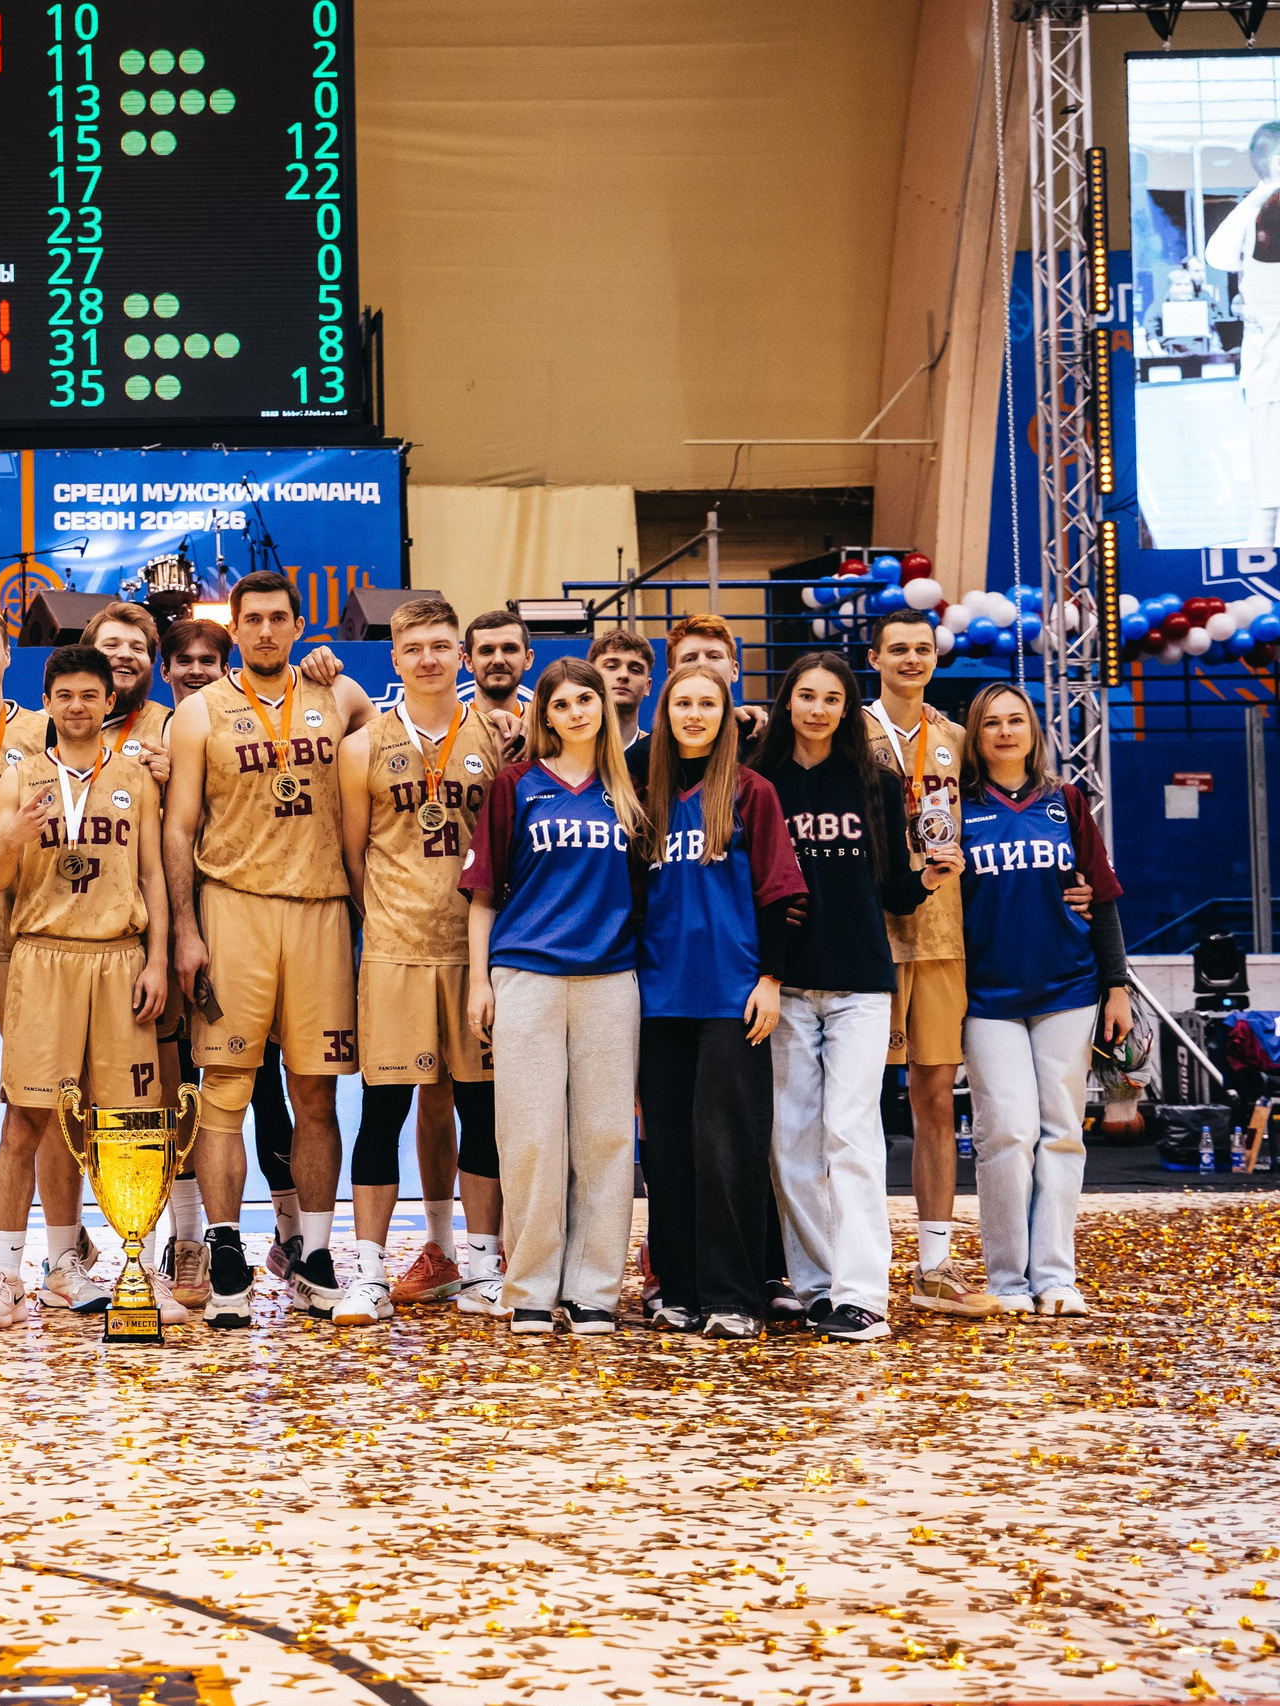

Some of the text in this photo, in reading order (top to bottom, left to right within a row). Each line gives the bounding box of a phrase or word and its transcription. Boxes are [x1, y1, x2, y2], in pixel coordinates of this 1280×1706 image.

[46, 3, 99, 41] 10
[312, 1, 337, 38] 0
[46, 44, 93, 81] 11
[312, 40, 338, 78] 2
[47, 85, 100, 122] 13
[314, 81, 338, 119] 0
[48, 125, 101, 163] 15
[286, 122, 340, 160] 12
[49, 166, 102, 203] 17
[285, 163, 341, 200] 22
[47, 206, 103, 244] 23
[316, 203, 341, 241] 0
[47, 247, 103, 285] 27
[317, 244, 342, 281] 0
[48, 288, 104, 325] 28
[318, 284, 343, 322] 5
[48, 329, 98, 366] 31
[318, 325, 344, 363] 8
[49, 370, 105, 407] 35
[291, 366, 345, 404] 13
[53, 481, 381, 507] СРЕДИ МУЖСКИХ КОМАНД
[53, 510, 246, 532] СЕЗОН 2025/26
[528, 818, 628, 853] ЦИВС
[969, 839, 1072, 876] ЦИВС
[322, 1029, 354, 1063] 35
[129, 1062, 155, 1098] 17
[131, 1320, 158, 1328] МЕСТО
